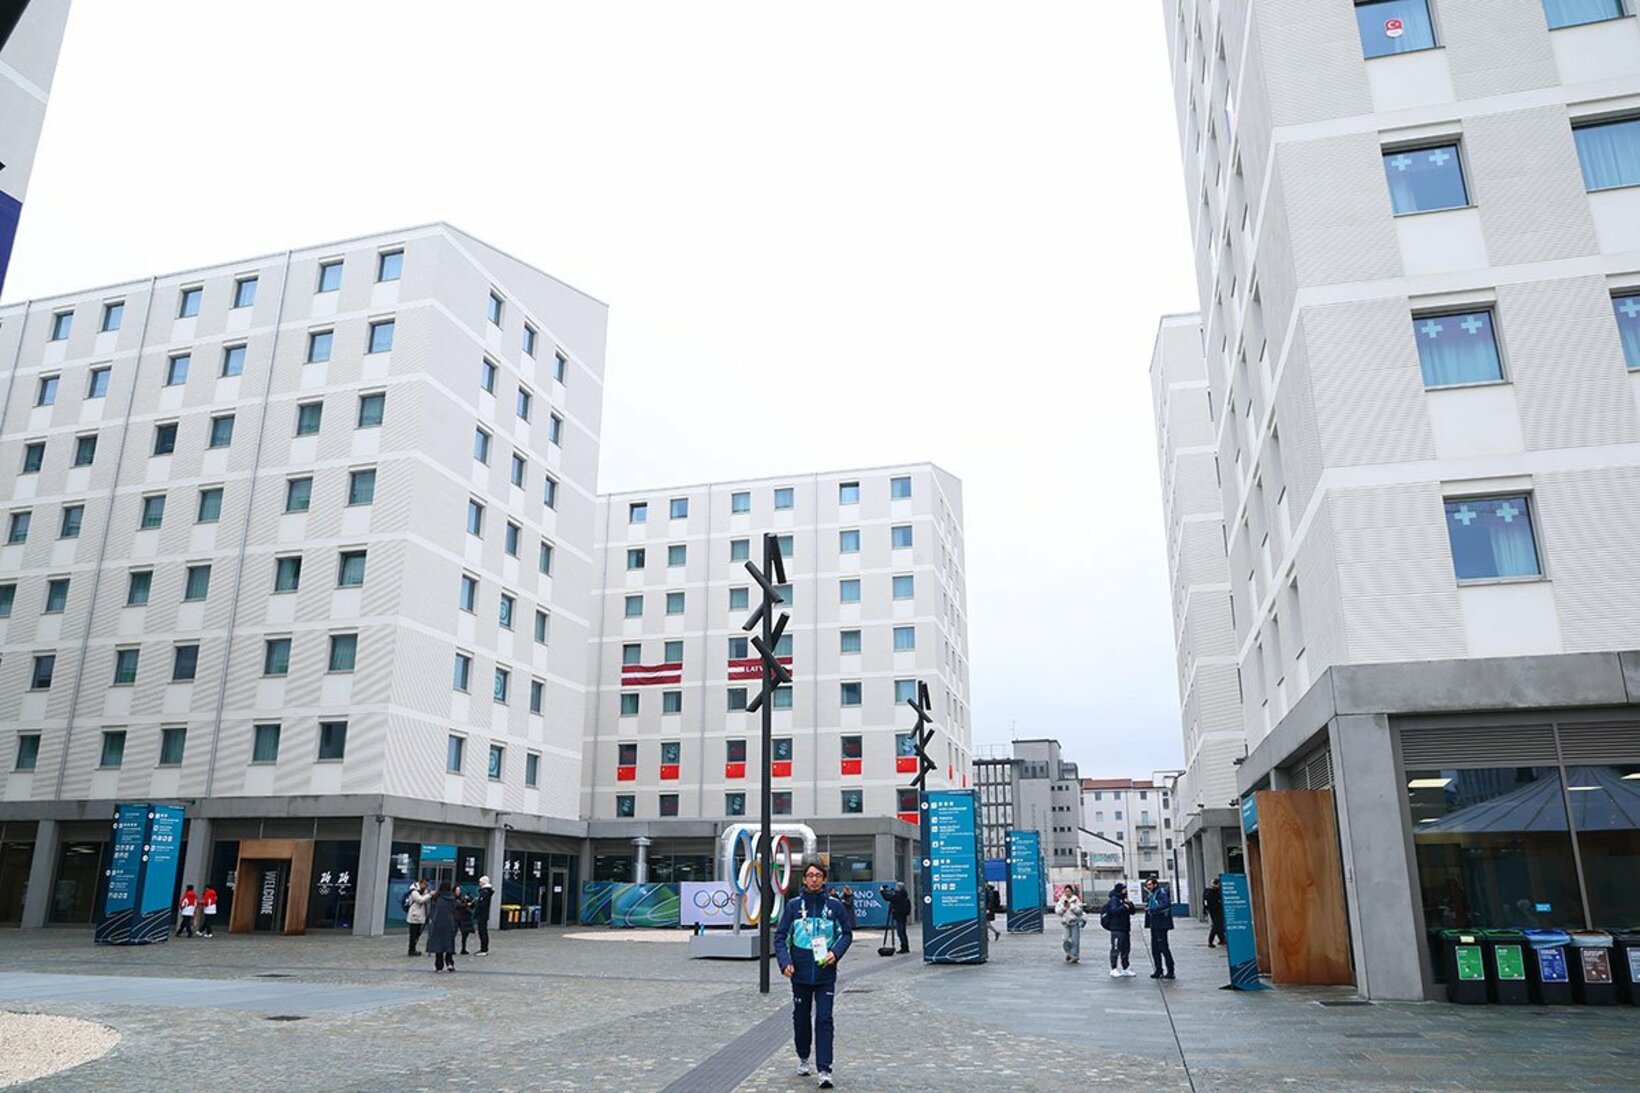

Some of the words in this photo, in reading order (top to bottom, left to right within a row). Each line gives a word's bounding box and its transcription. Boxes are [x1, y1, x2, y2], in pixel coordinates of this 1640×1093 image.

[745, 665, 764, 673] LATV
[260, 870, 277, 915] WELCOME
[853, 899, 882, 908] RTINA
